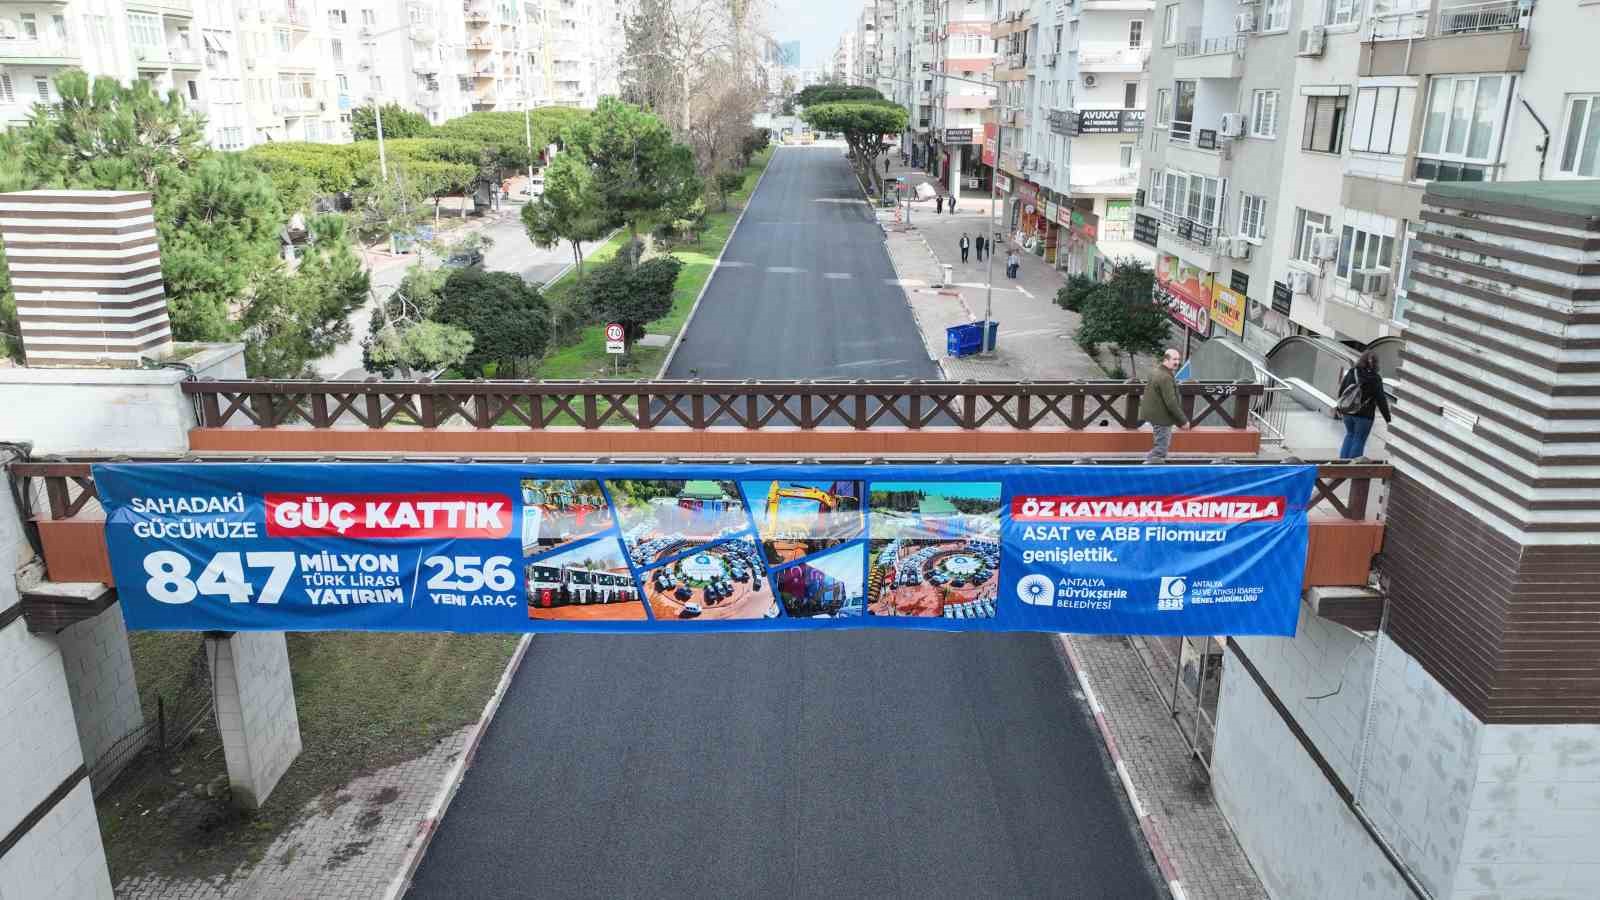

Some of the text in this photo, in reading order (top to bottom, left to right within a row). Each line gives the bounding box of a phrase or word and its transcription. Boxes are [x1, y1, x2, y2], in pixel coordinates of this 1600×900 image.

[1082, 110, 1120, 119] AVUKAT
[609, 327, 621, 337] 70
[131, 492, 245, 513] SAHADAKİ
[1021, 498, 1279, 519] ÖZ KAYNAKLARIMIZLA
[275, 496, 504, 534] GÜÇ KATTIK
[133, 518, 258, 538] GÜCÜMÜZE
[1022, 526, 1227, 542] ASAT ve ABB Filomuzu
[300, 550, 399, 572] MİLYON
[1022, 547, 1118, 564] genişlettik.
[143, 550, 297, 604] 847
[302, 573, 400, 587] TÜRK LİRASI
[424, 555, 516, 592] 256
[1058, 577, 1106, 587] ANTALYA
[1191, 580, 1224, 588] ANTALYA
[305, 588, 404, 605] YATIRIM
[470, 594, 518, 608] ARAÇ
[1057, 587, 1128, 601] BÜYÜKŞEHİR
[1056, 599, 1112, 611] BELEDİYESİ
